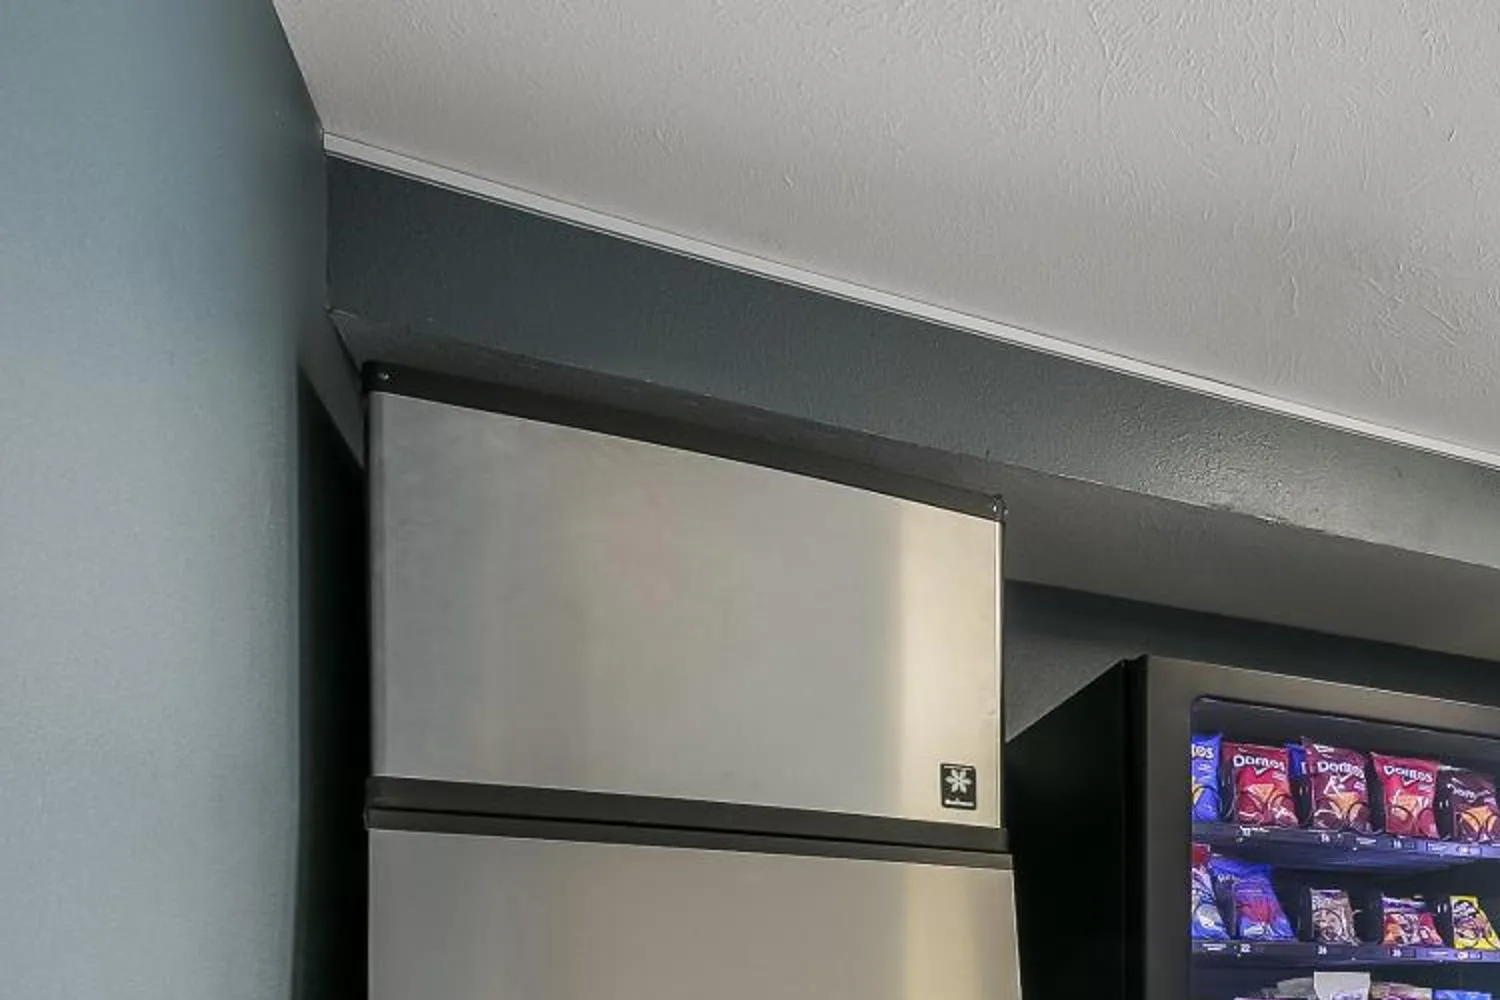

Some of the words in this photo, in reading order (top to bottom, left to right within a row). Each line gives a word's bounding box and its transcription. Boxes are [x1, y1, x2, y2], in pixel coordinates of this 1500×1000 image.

[1232, 755, 1286, 771] Doritos
[1317, 761, 1366, 780] Doritos
[1383, 764, 1433, 783] Doritos
